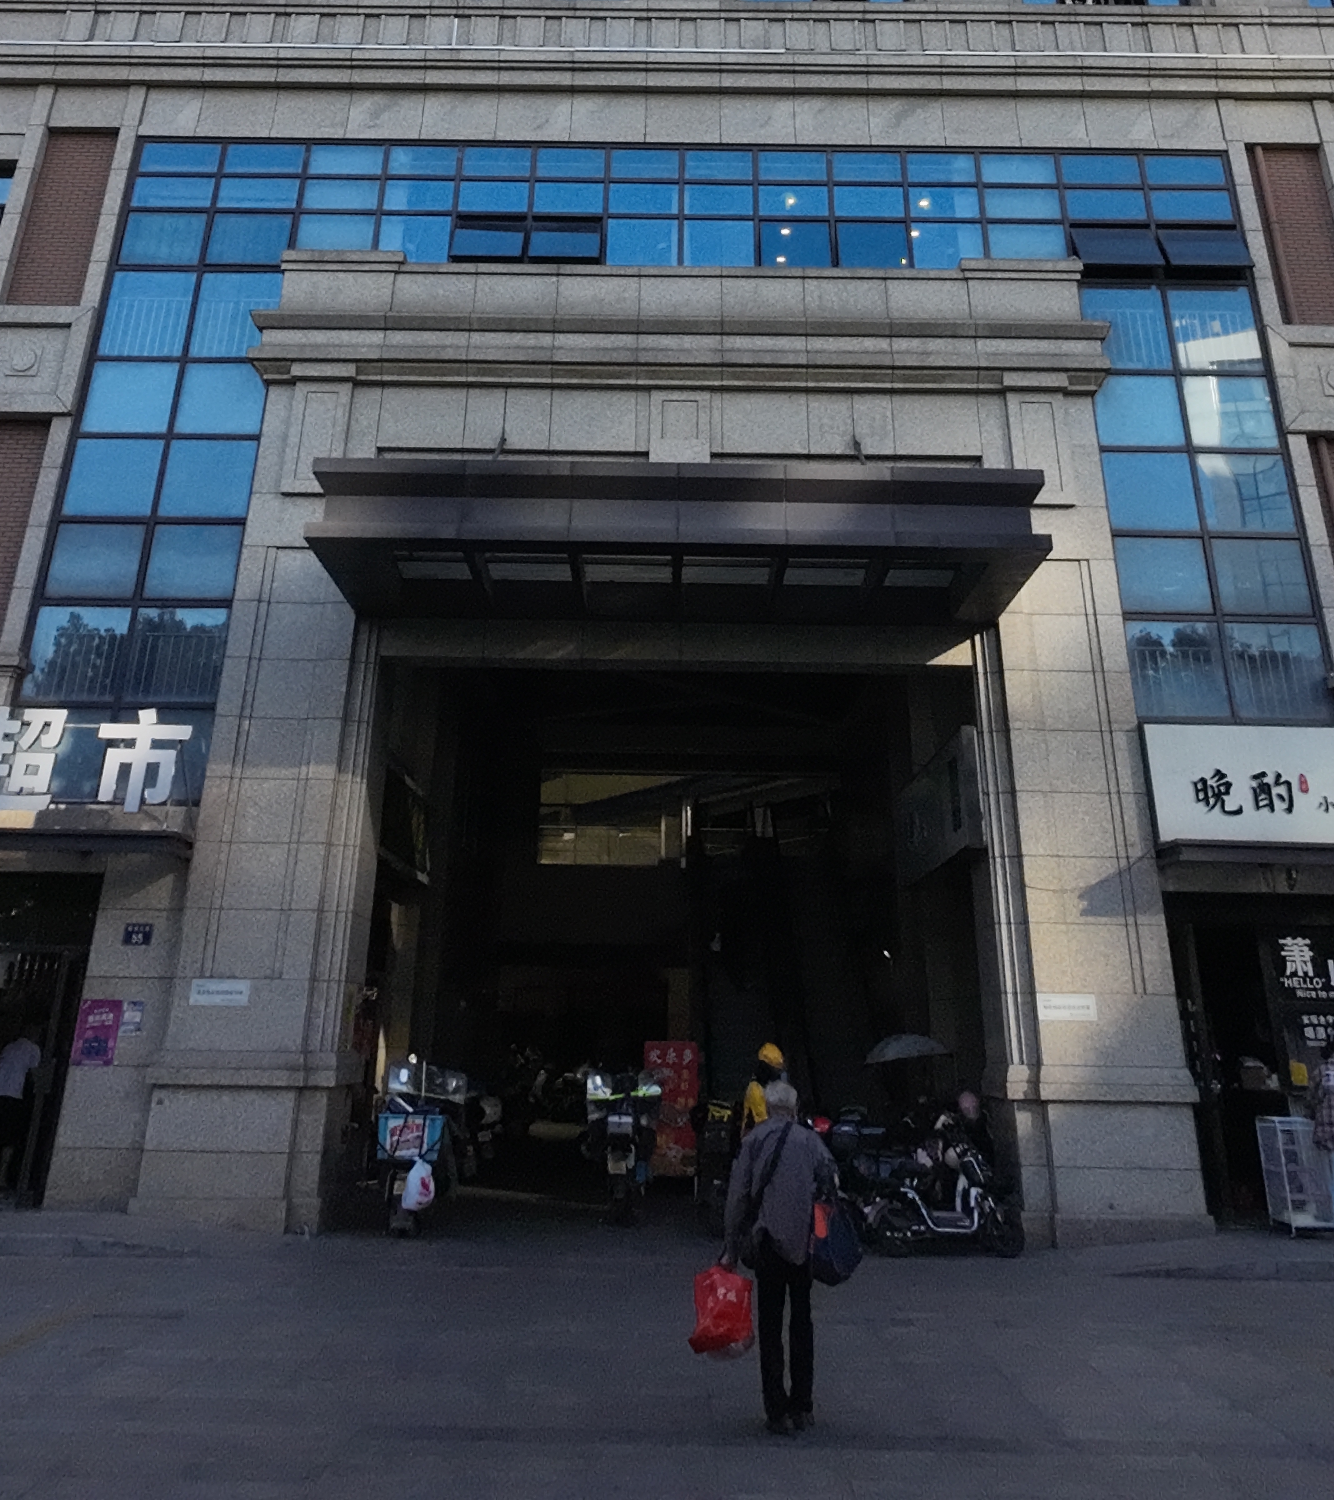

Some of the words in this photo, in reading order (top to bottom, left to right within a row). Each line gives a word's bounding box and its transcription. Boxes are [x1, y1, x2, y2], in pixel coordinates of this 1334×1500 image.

[1192, 768, 1295, 816] 晚酌
[1296, 988, 1317, 999] Nice
[1319, 989, 1328, 999] to
